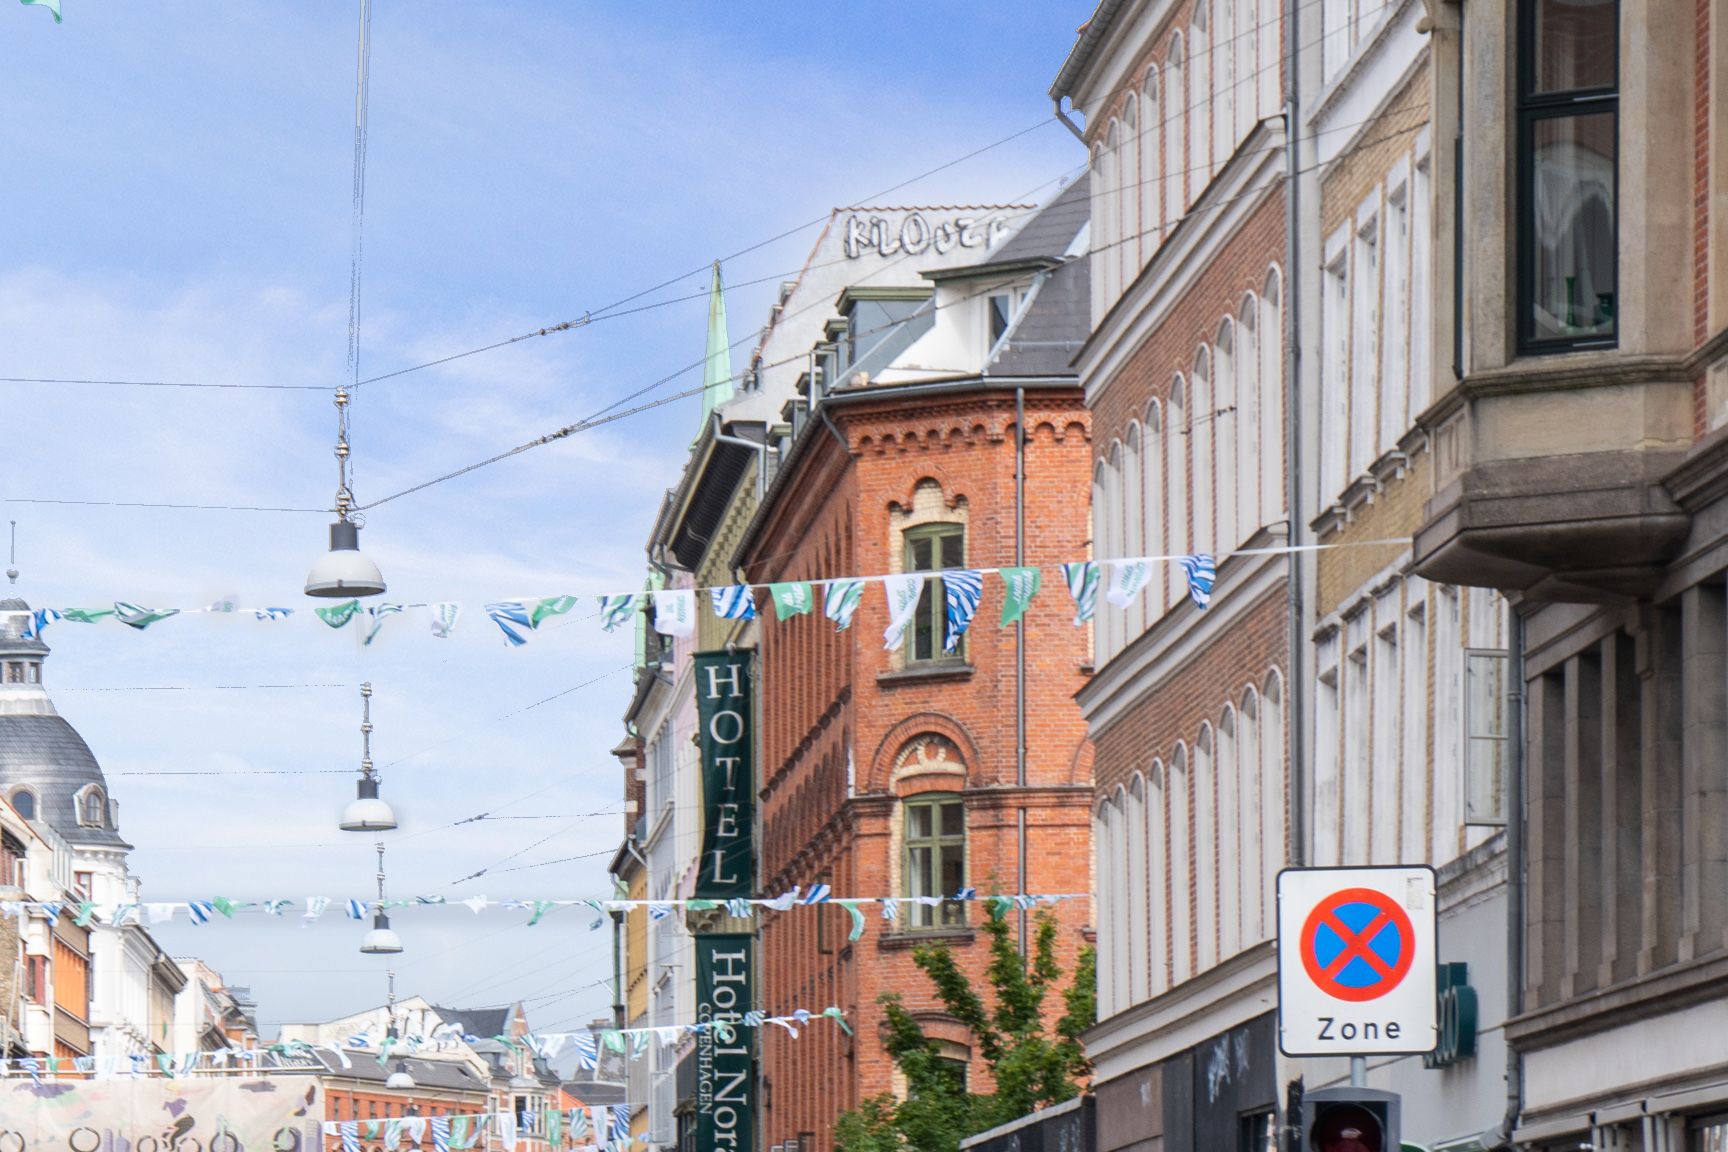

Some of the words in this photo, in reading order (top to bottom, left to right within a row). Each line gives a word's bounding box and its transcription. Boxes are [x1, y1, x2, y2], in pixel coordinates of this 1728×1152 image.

[703, 663, 745, 883] HOTEL
[698, 1002, 713, 1115] COPENHAGEN
[712, 948, 748, 1058] Hotel
[1317, 1017, 1401, 1040] Zone
